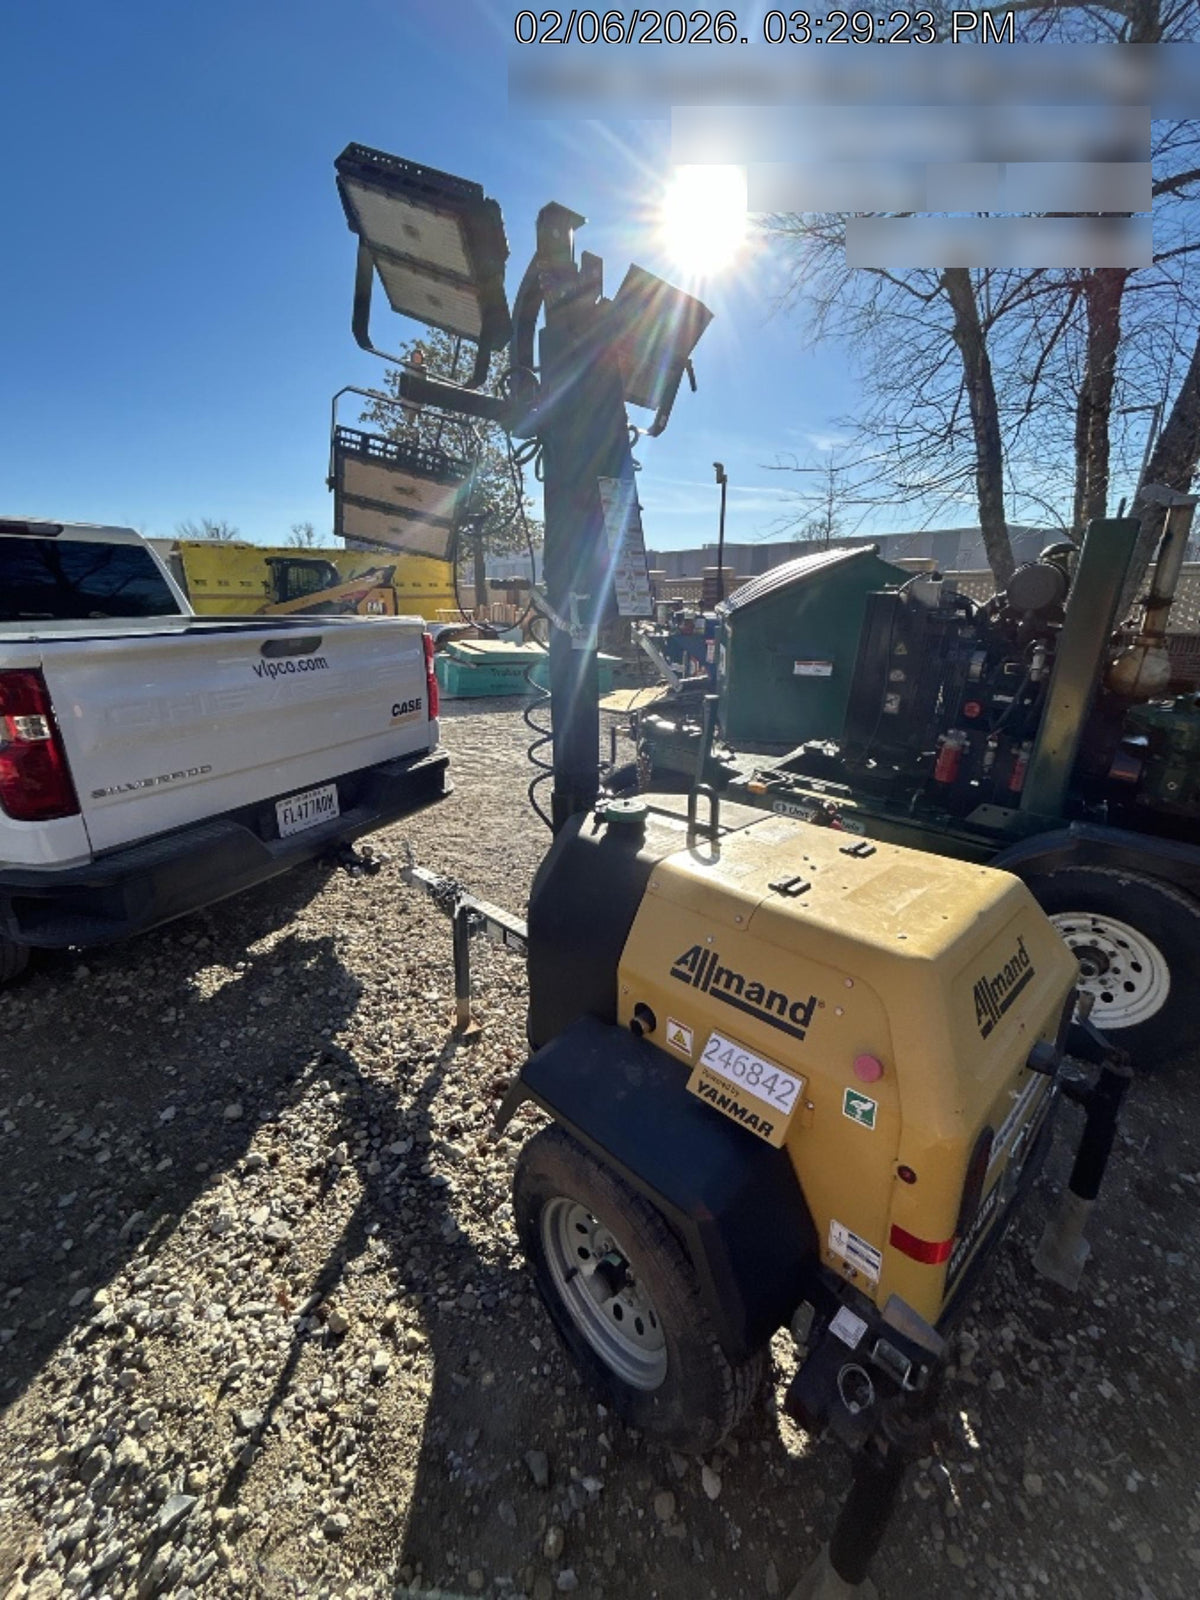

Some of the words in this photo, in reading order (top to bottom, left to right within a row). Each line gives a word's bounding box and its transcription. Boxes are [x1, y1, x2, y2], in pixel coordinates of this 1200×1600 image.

[252, 655, 330, 679] vlpco.com
[391, 698, 422, 717] CASE
[90, 764, 213, 799] SILVERADO
[672, 944, 818, 1032] Allmand
[973, 935, 1031, 1027] Allmand
[701, 1069, 731, 1091] Powered
[730, 1086, 740, 1097] by
[703, 1037, 796, 1106] 246842
[697, 1080, 775, 1138] YANMAR
